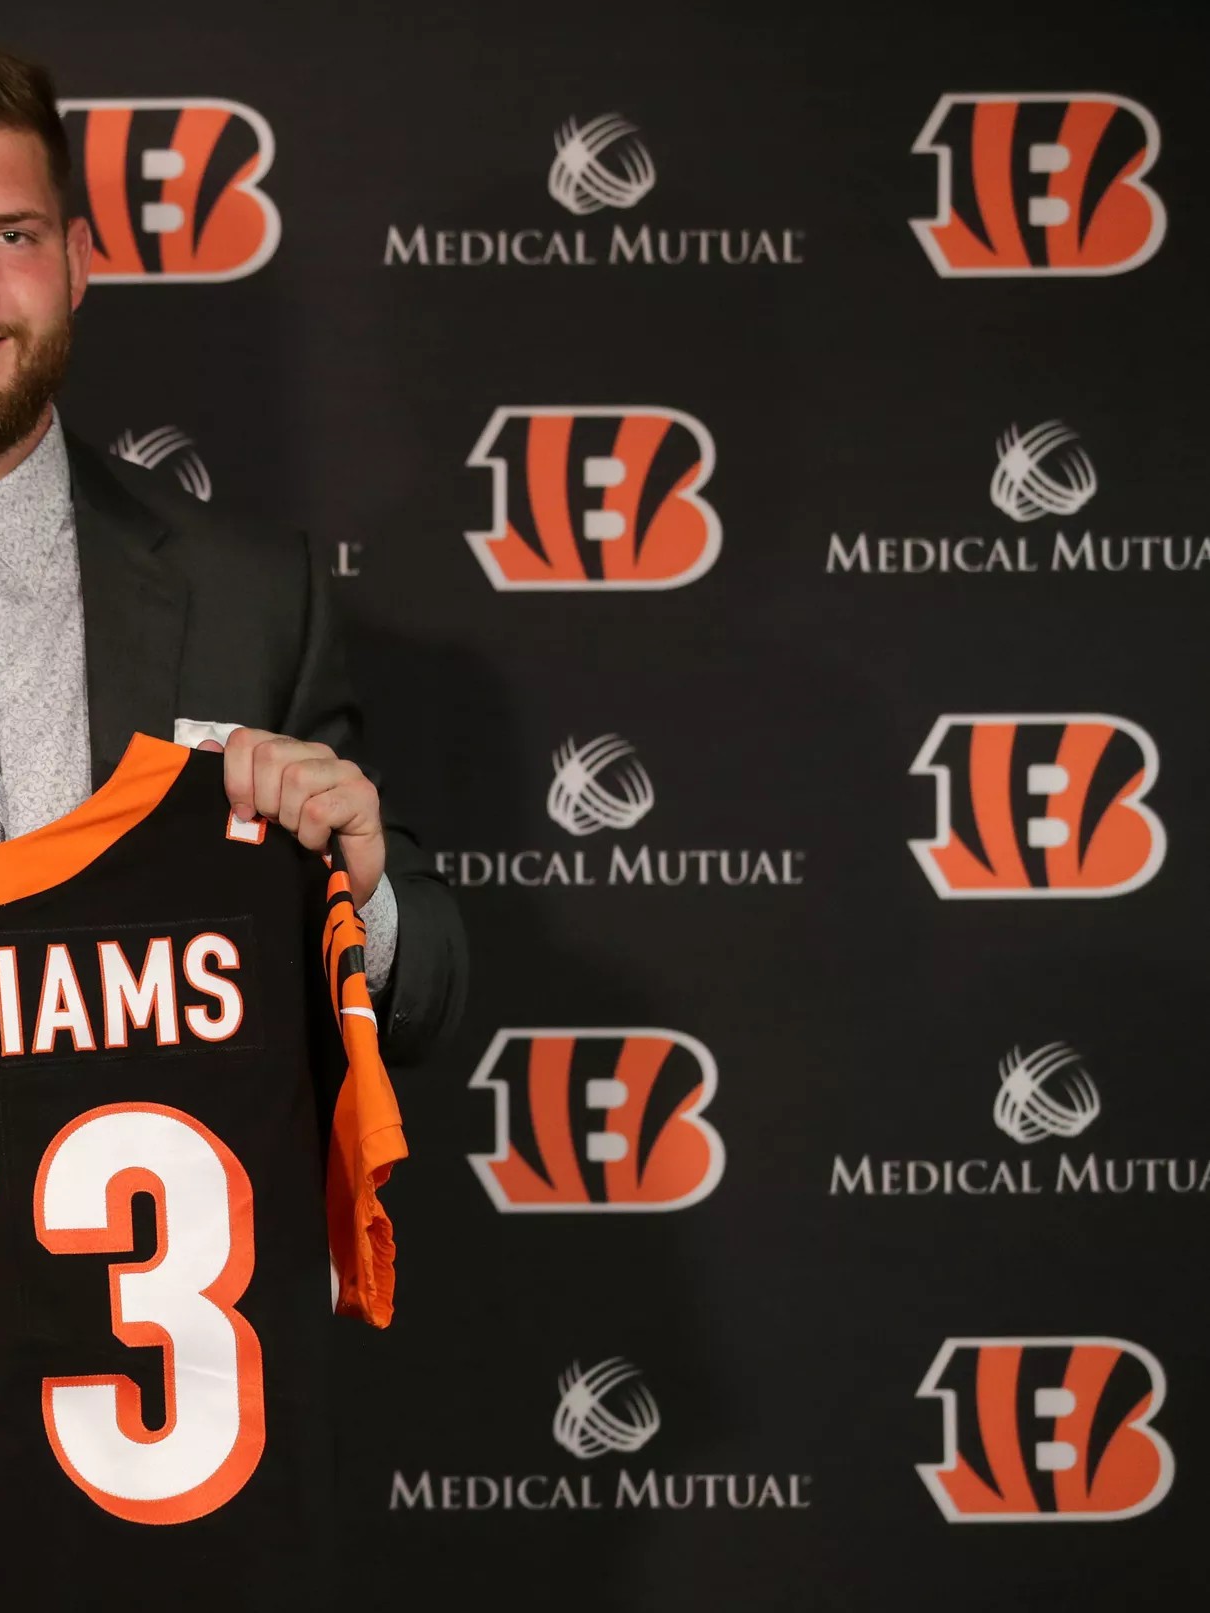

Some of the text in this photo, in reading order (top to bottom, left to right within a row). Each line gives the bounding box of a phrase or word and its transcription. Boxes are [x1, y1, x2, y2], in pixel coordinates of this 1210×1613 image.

[384, 225, 803, 265] MEDICAL MUTUAL
[825, 531, 1210, 573] MEDICAL MUTUA
[436, 845, 803, 886] EDICAL MUTUAL
[829, 1154, 1041, 1195] MEDICAL
[389, 1470, 809, 1510] MEDICAL MUTUAL
